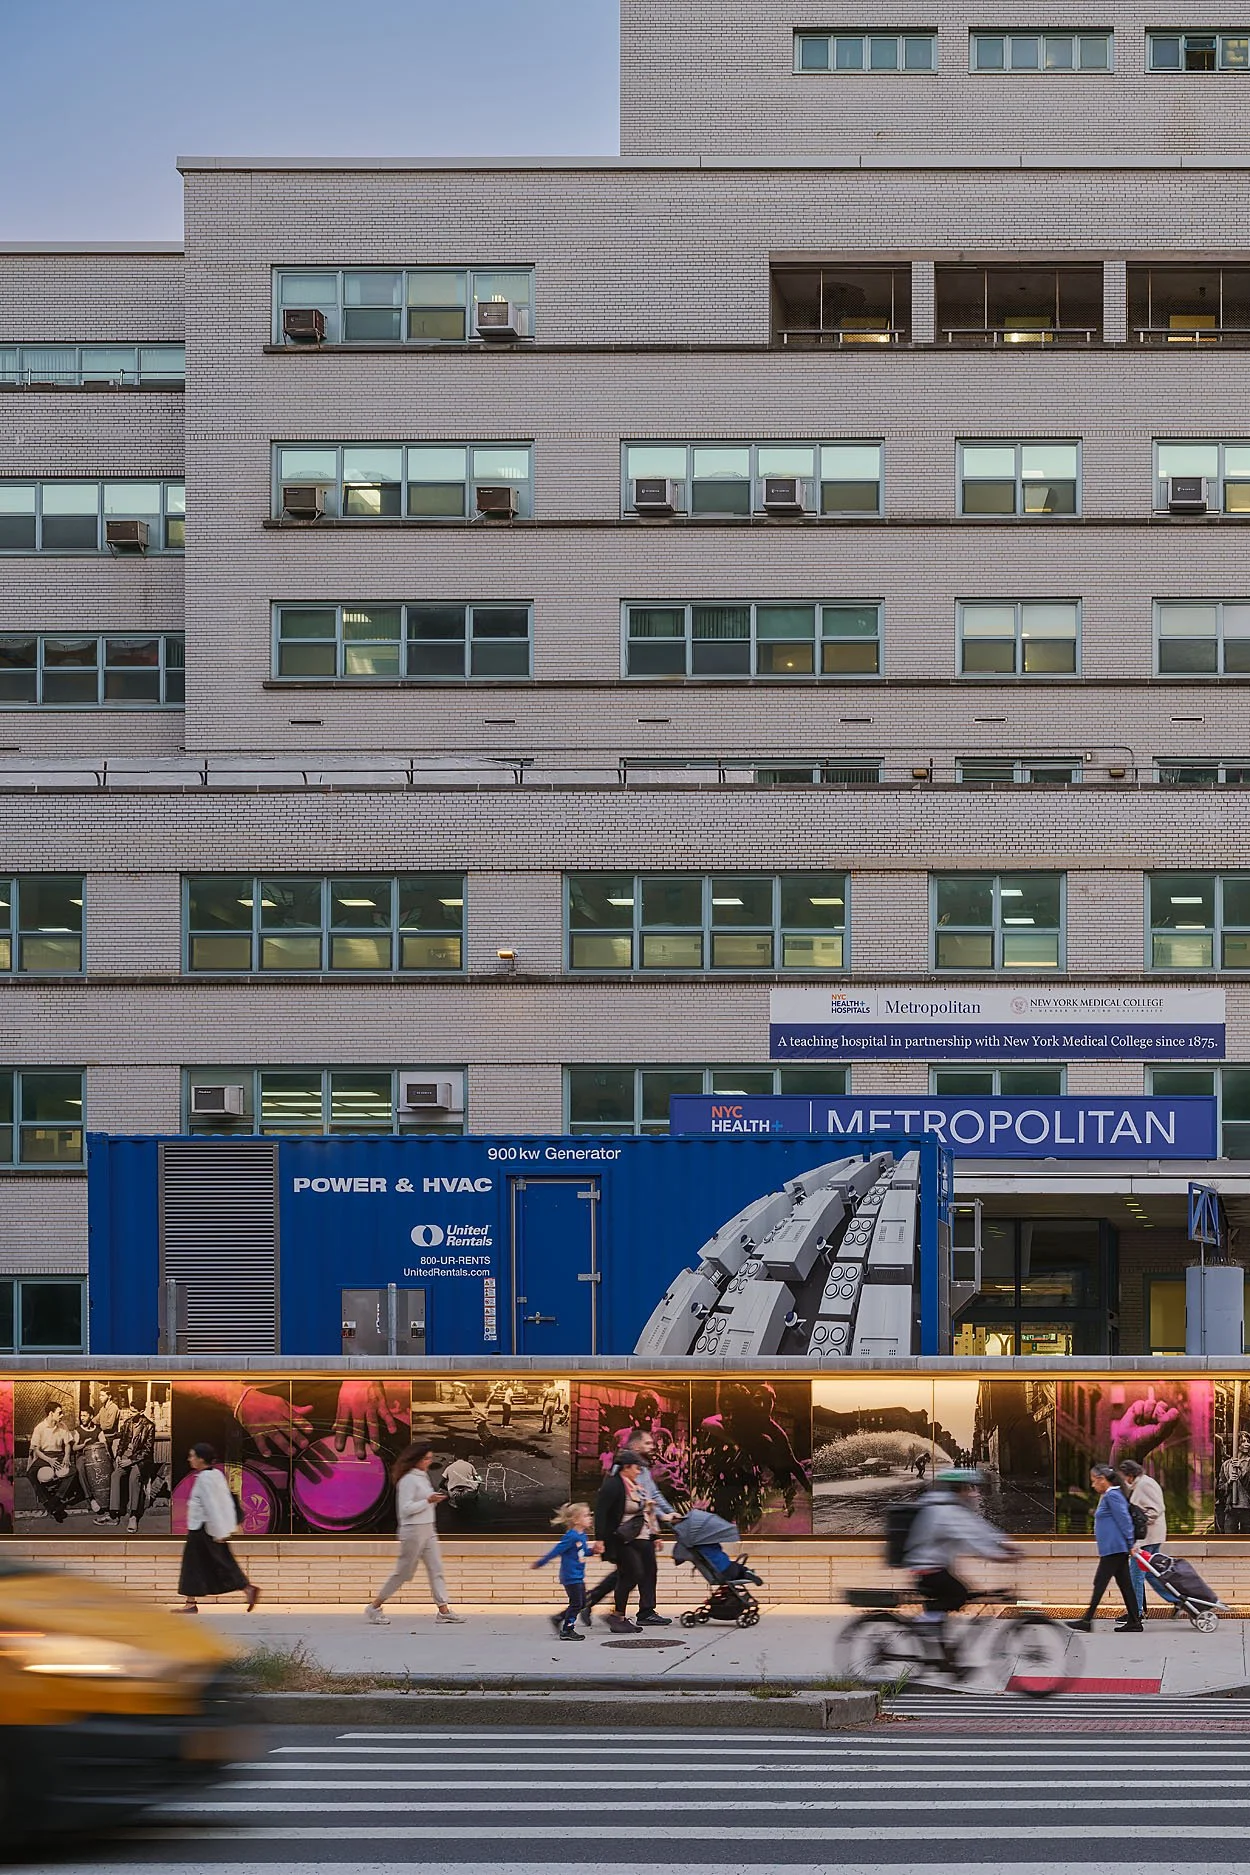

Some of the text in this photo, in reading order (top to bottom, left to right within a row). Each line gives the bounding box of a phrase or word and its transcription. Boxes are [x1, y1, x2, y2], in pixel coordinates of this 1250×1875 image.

[885, 1000, 980, 1016] Metropolitan
[777, 1035, 1218, 1049] A teaching hospital in partnership with New York Medical College since 1875.
[711, 1105, 743, 1118] NYC
[487, 1147, 622, 1161] 900 kw Generator
[293, 1177, 493, 1193] POWER & HVAC
[445, 1236, 493, 1247] Rentals
[419, 1256, 491, 1265] 800-UR-RENTS
[403, 1267, 491, 1278] UnitedRentals.com
